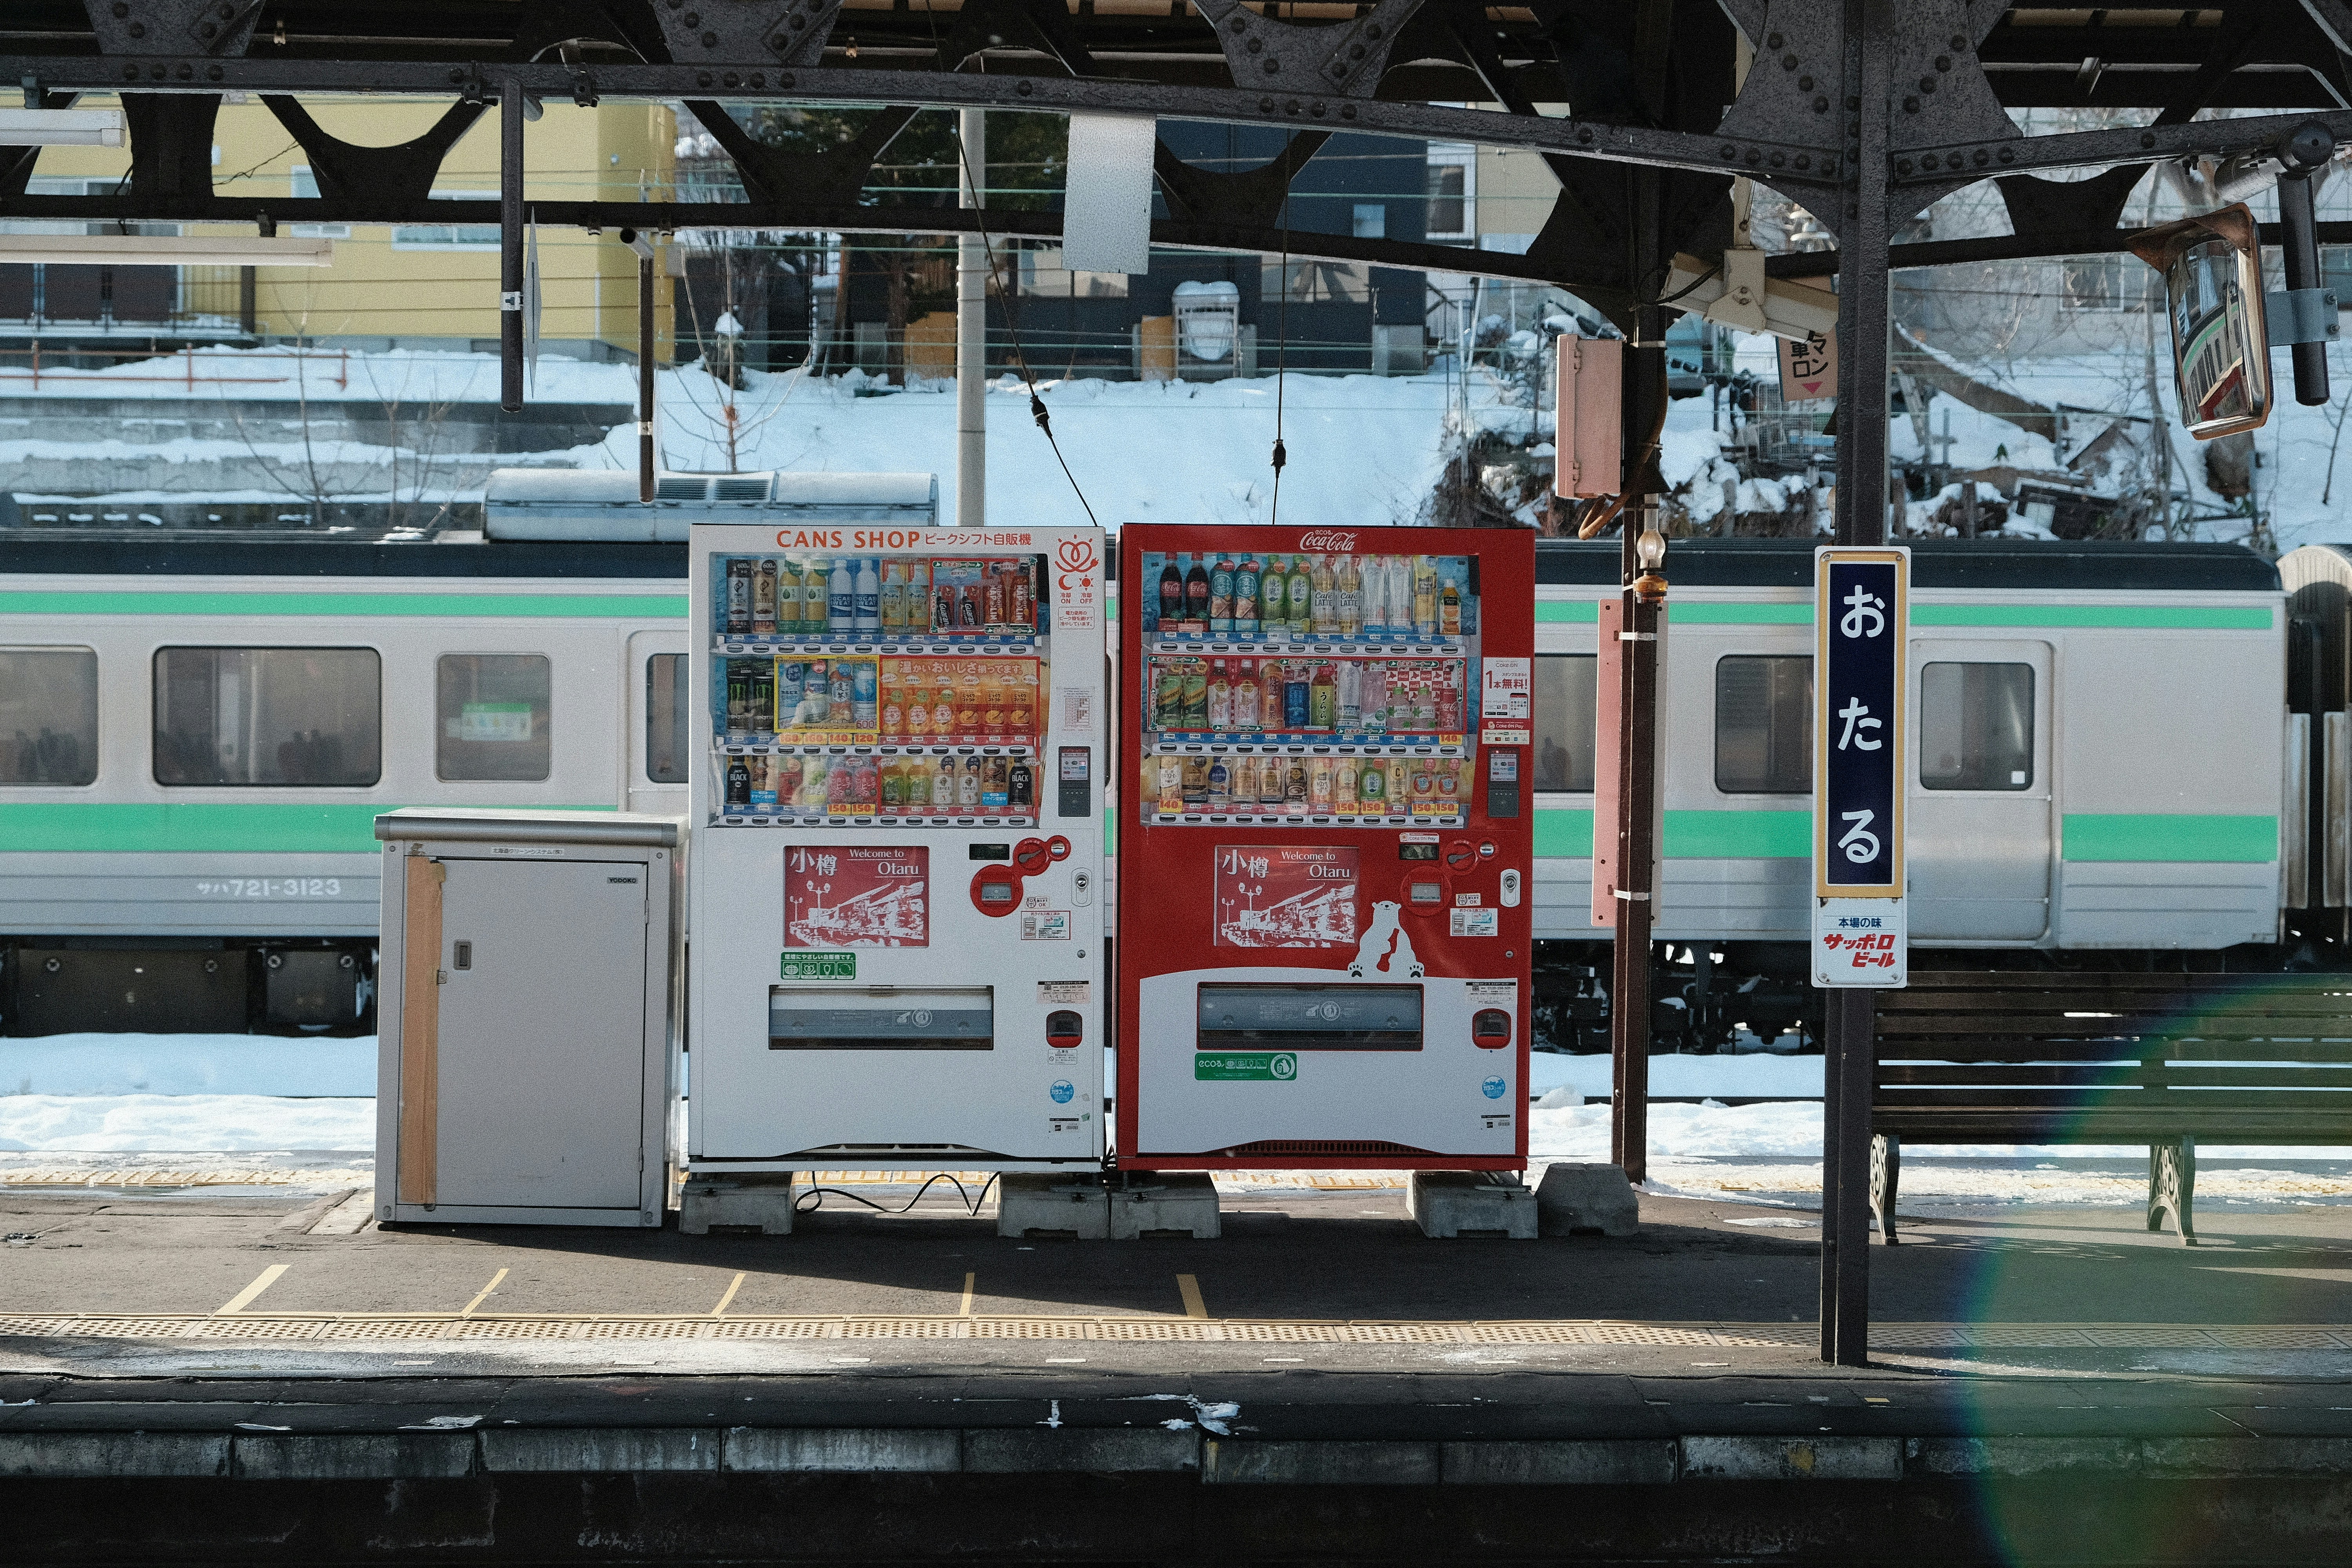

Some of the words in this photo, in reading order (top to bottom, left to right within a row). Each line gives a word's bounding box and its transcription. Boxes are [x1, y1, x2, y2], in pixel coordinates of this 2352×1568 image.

[776, 530, 842, 548] CANS
[855, 530, 920, 548] SHOP
[926, 534, 1031, 545] ピークシフト自販機
[1299, 532, 1358, 551] Coca-Cola
[899, 661, 1024, 674] 温かいおいしさ揃ってます。
[1486, 670, 1528, 689] 1本無料!
[1837, 585, 1886, 864] おたる
[789, 848, 838, 876] 小樽
[849, 849, 891, 858] Welcome
[894, 849, 904, 858] to
[1281, 851, 1323, 860] Welcome
[1326, 852, 1336, 860] to
[878, 862, 918, 875] Otaru
[1222, 849, 1269, 878] 小樽
[1309, 864, 1350, 878] Otaru
[197, 879, 341, 896] サハ721-3123
[1838, 917, 1882, 928] 本場の味
[1824, 933, 1896, 950] サッポロ
[1852, 952, 1896, 967] ビール
